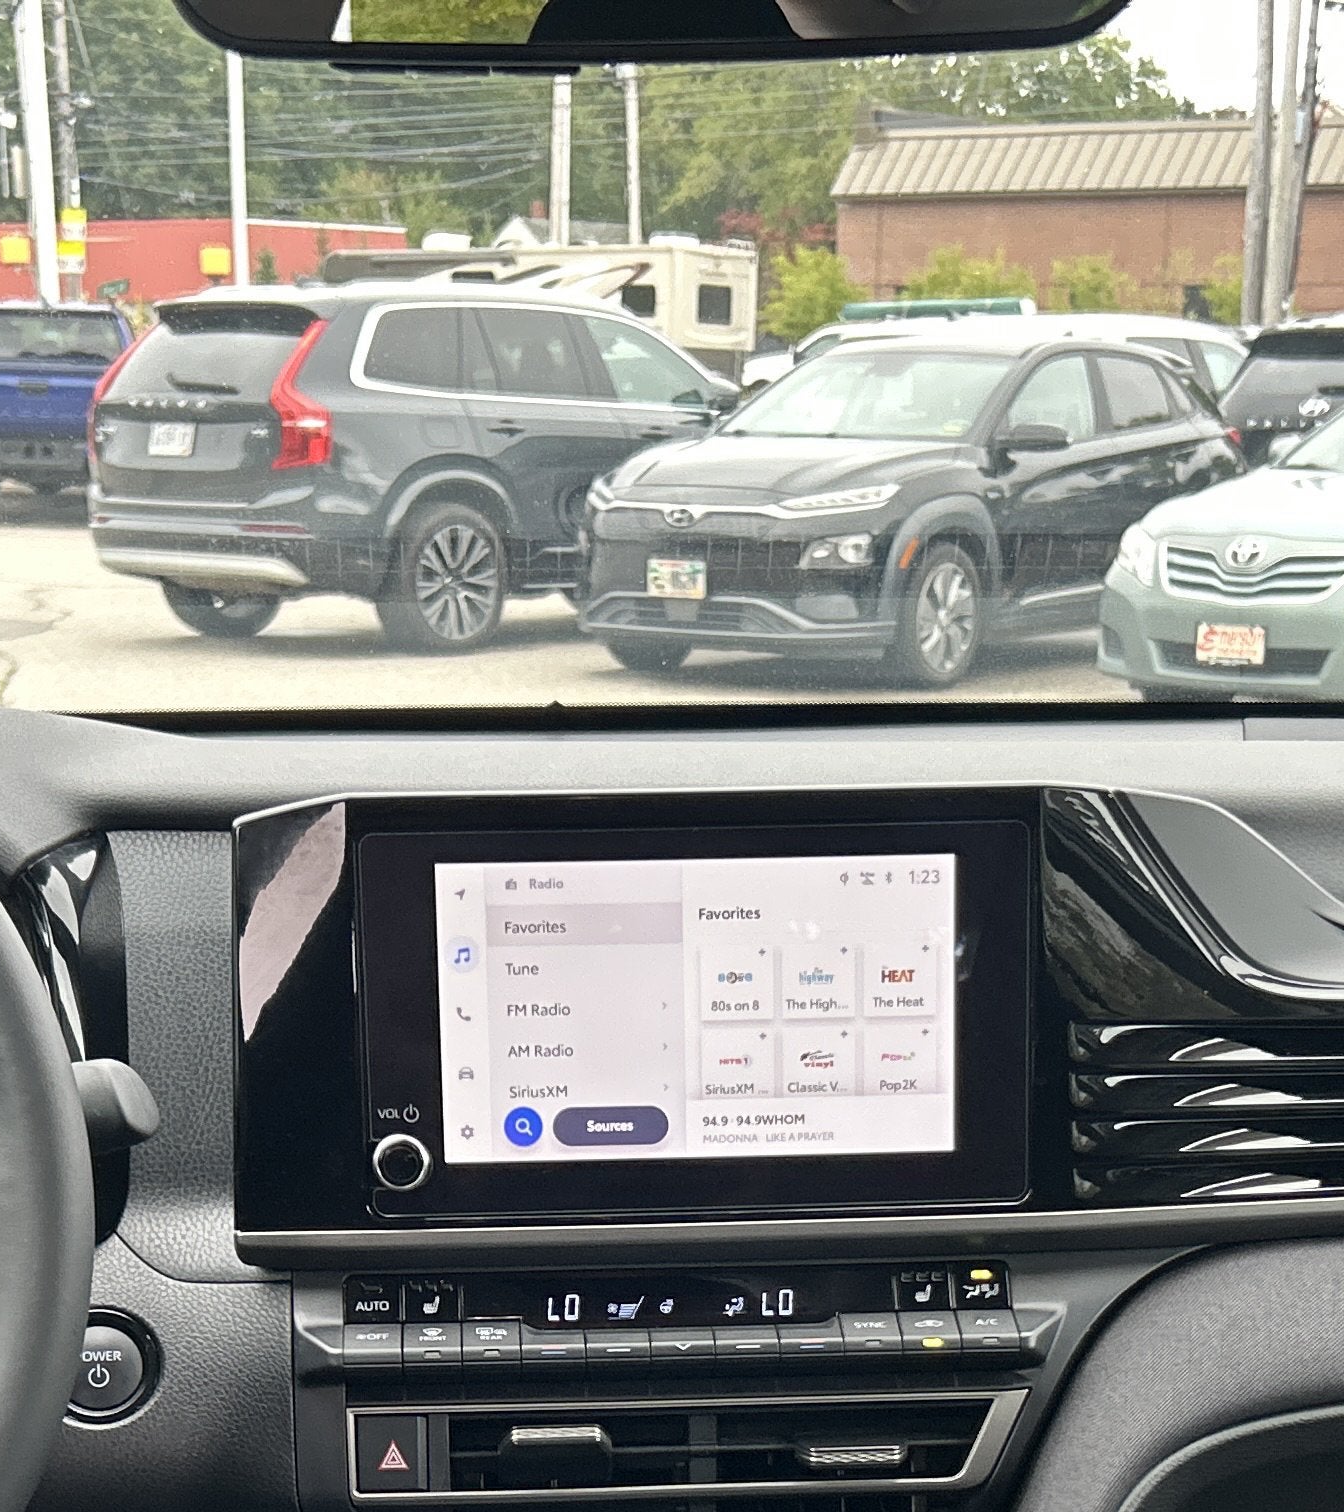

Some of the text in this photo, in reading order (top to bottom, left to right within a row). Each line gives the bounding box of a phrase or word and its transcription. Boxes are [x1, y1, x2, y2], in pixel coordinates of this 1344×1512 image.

[908, 870, 941, 885] 1:23
[529, 878, 564, 890] Radio
[698, 906, 761, 921] Favorites
[504, 920, 567, 934] Favorites
[505, 963, 540, 976] Tune
[881, 969, 915, 984] HEAT
[711, 1000, 760, 1012] 80s on 8
[786, 999, 807, 1010] The
[873, 996, 924, 1008] The Heat
[507, 1003, 571, 1016] FM Radio
[508, 1044, 573, 1058] AM Radio
[509, 1085, 568, 1098] SiriusXM
[705, 1083, 754, 1095] SiriusXM
[788, 1081, 828, 1093] Classic
[880, 1079, 917, 1092] Pop2K
[377, 1108, 401, 1119] VOL
[586, 1119, 634, 1132] Sources
[702, 1114, 805, 1127] 94.9 94.9WHOM
[702, 1131, 835, 1144] MADONNA LIKE A PRAYER
[356, 1301, 390, 1312] AUTO
[853, 1321, 888, 1330] SYNC
[975, 1318, 999, 1327] A/C
[367, 1333, 390, 1341] OFF
[81, 1350, 122, 1362] OWER
